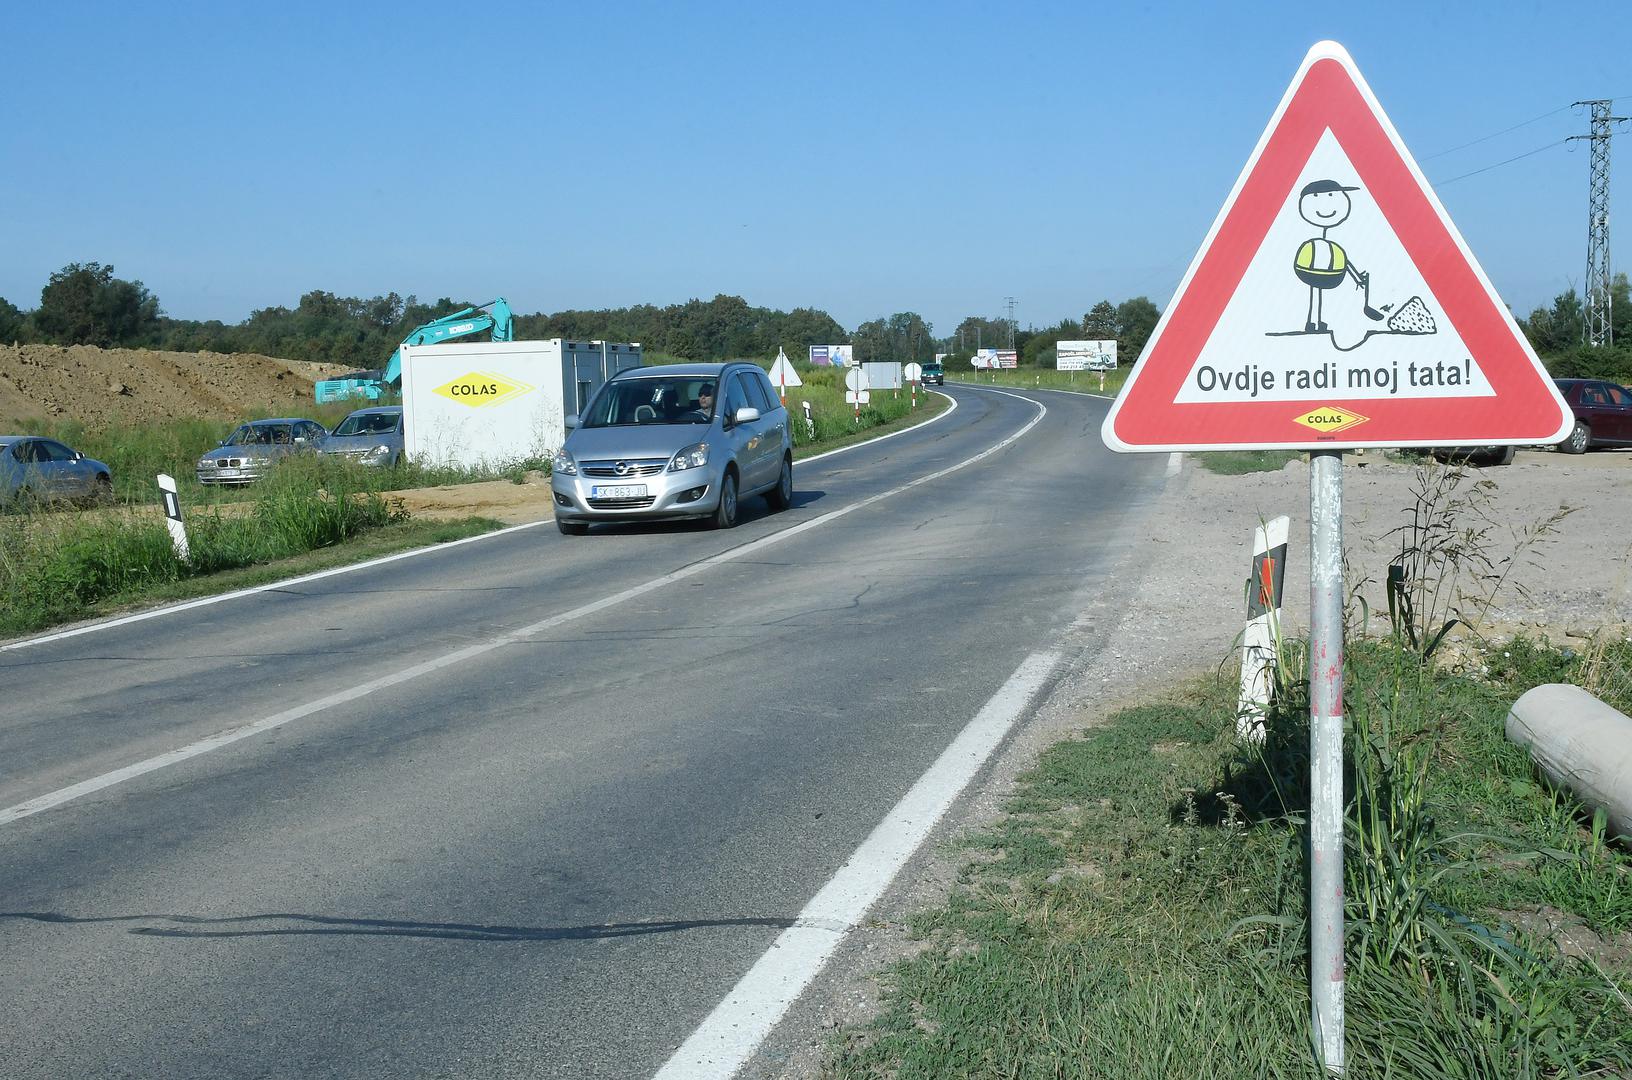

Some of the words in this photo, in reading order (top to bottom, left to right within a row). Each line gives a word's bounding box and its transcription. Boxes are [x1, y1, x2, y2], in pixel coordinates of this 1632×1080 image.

[1196, 365, 1275, 397] Ovdje
[1285, 362, 1337, 389] radi
[1347, 361, 1398, 394] moj
[1408, 358, 1472, 387] tata!
[451, 384, 497, 396] COLAS
[1307, 415, 1342, 424] COLAS
